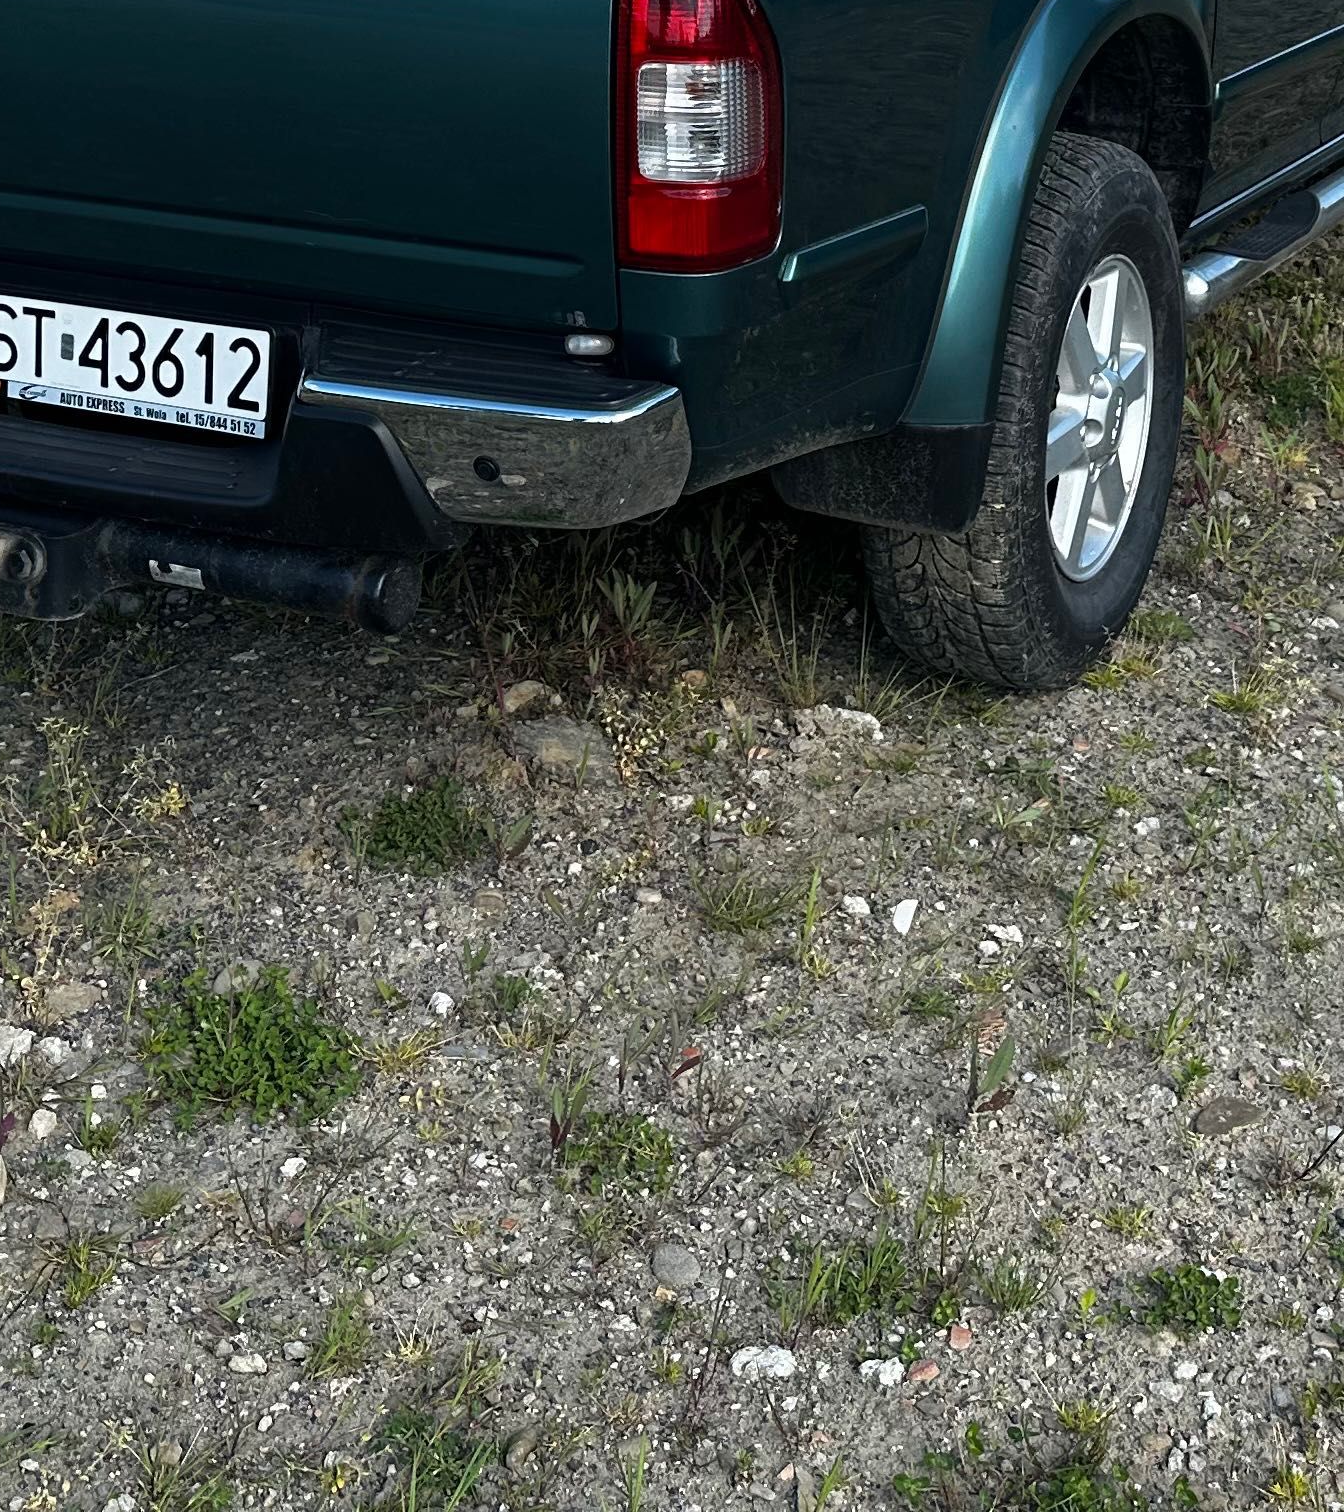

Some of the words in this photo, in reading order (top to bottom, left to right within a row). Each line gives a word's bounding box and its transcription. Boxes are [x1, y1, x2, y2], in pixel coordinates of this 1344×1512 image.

[78, 317, 261, 413] 43612
[60, 392, 83, 407] AUTO
[86, 396, 125, 414] EXPRESS
[146, 407, 167, 421] Wola
[176, 410, 191, 425] tel.
[194, 413, 228, 430] 15/844
[230, 419, 241, 433] 51
[244, 421, 256, 436] 52
